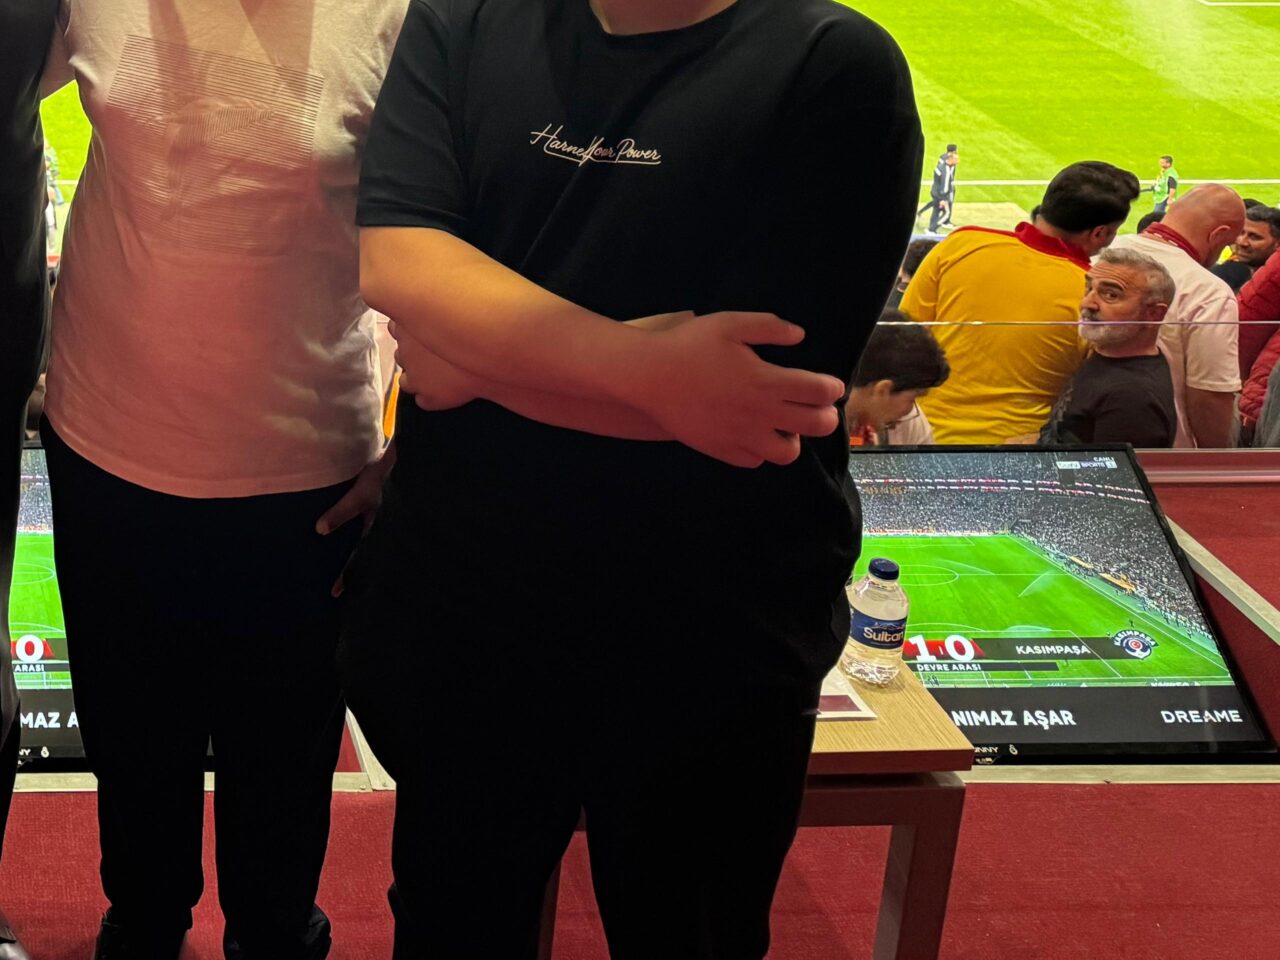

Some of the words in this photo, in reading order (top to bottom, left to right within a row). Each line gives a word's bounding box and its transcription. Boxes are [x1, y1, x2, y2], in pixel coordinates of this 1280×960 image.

[615, 138, 661, 163] Power
[909, 634, 937, 662] 1
[1016, 645, 1091, 656] KASIMPAŞA
[916, 663, 951, 672] DEVRE
[952, 663, 981, 672] ARASI
[20, 712, 61, 729] MAZ
[951, 710, 1017, 726] NIMAZ
[1023, 710, 1077, 730] AŞAR
[1160, 709, 1243, 724] DREAME
